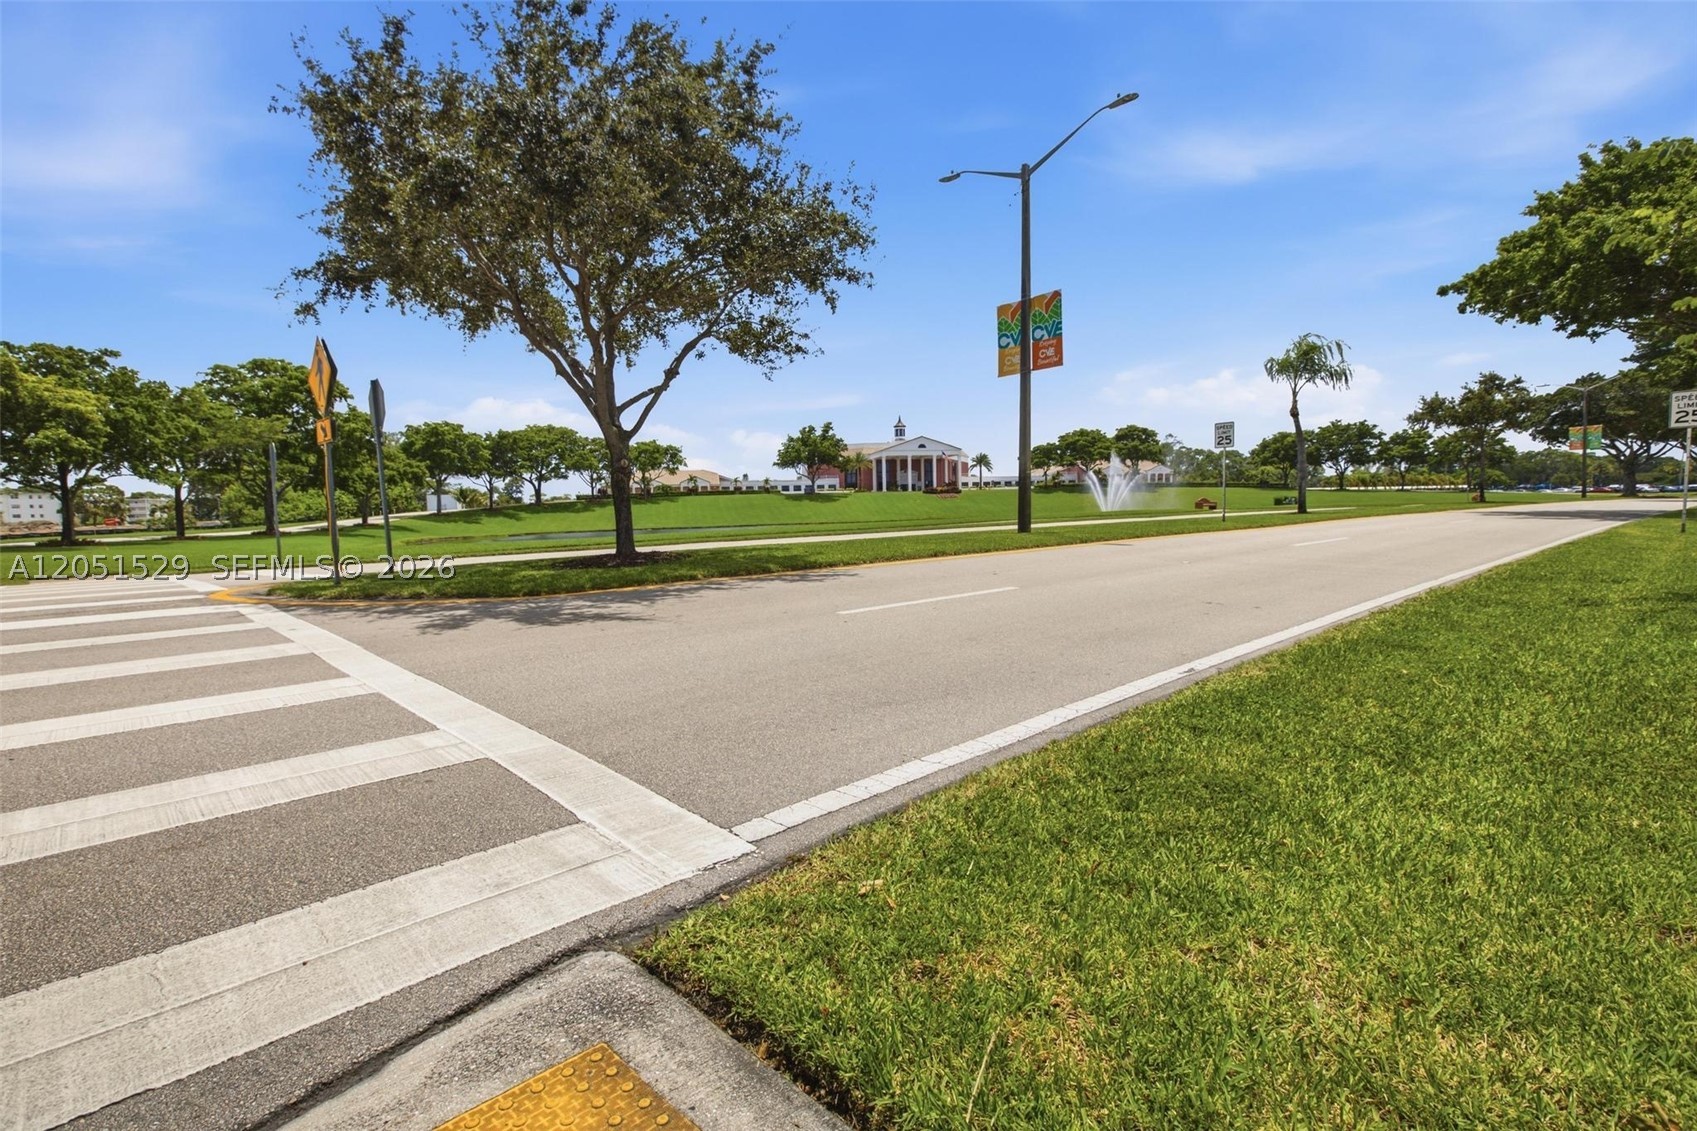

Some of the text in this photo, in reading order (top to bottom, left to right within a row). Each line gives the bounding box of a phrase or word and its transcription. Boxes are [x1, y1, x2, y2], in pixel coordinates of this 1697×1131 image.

[1032, 320, 1062, 342] CVE
[998, 329, 1021, 349] CV
[1674, 394, 1697, 402] SPE
[1217, 435, 1232, 445] 25
